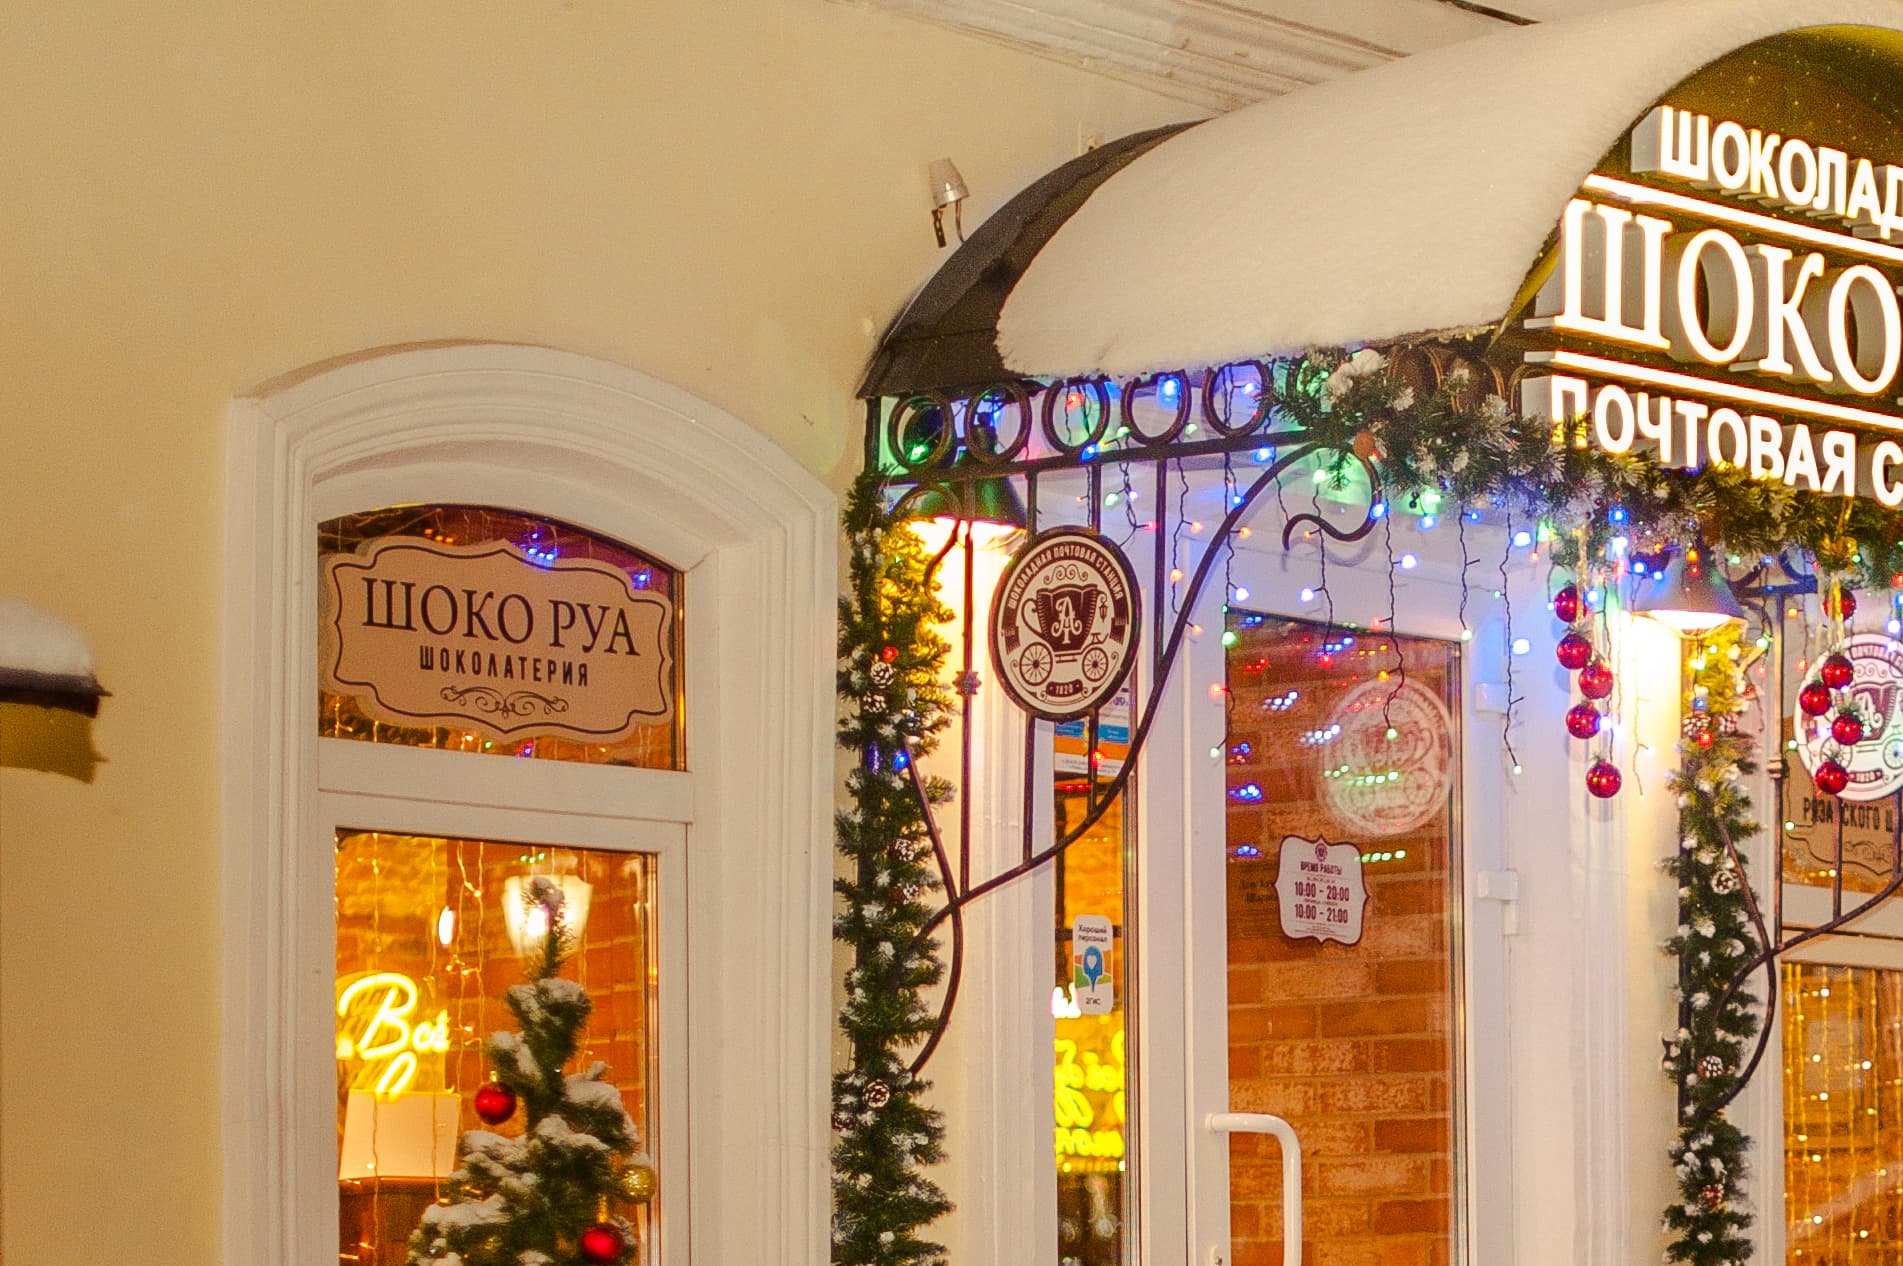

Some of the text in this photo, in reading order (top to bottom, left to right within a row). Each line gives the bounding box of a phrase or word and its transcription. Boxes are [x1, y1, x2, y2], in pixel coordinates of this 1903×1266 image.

[1553, 198, 1903, 397] ШОКО
[1550, 374, 1857, 498] ПОЧТОВАЯ
[1007, 545, 1124, 609] ШОКОЛАДНАЯ ПОЧТОВАЯ СТАНЦИЯ
[361, 576, 641, 657] ШОКО РУА
[419, 645, 589, 687] ШОКОЛАТЕРИЯ
[1803, 797, 1881, 831] РЯЗАСКОГО
[1295, 881, 1317, 898] 10:00
[1326, 885, 1350, 902] 20:00
[1295, 903, 1317, 920] 10:00
[1326, 907, 1349, 924] 21:00
